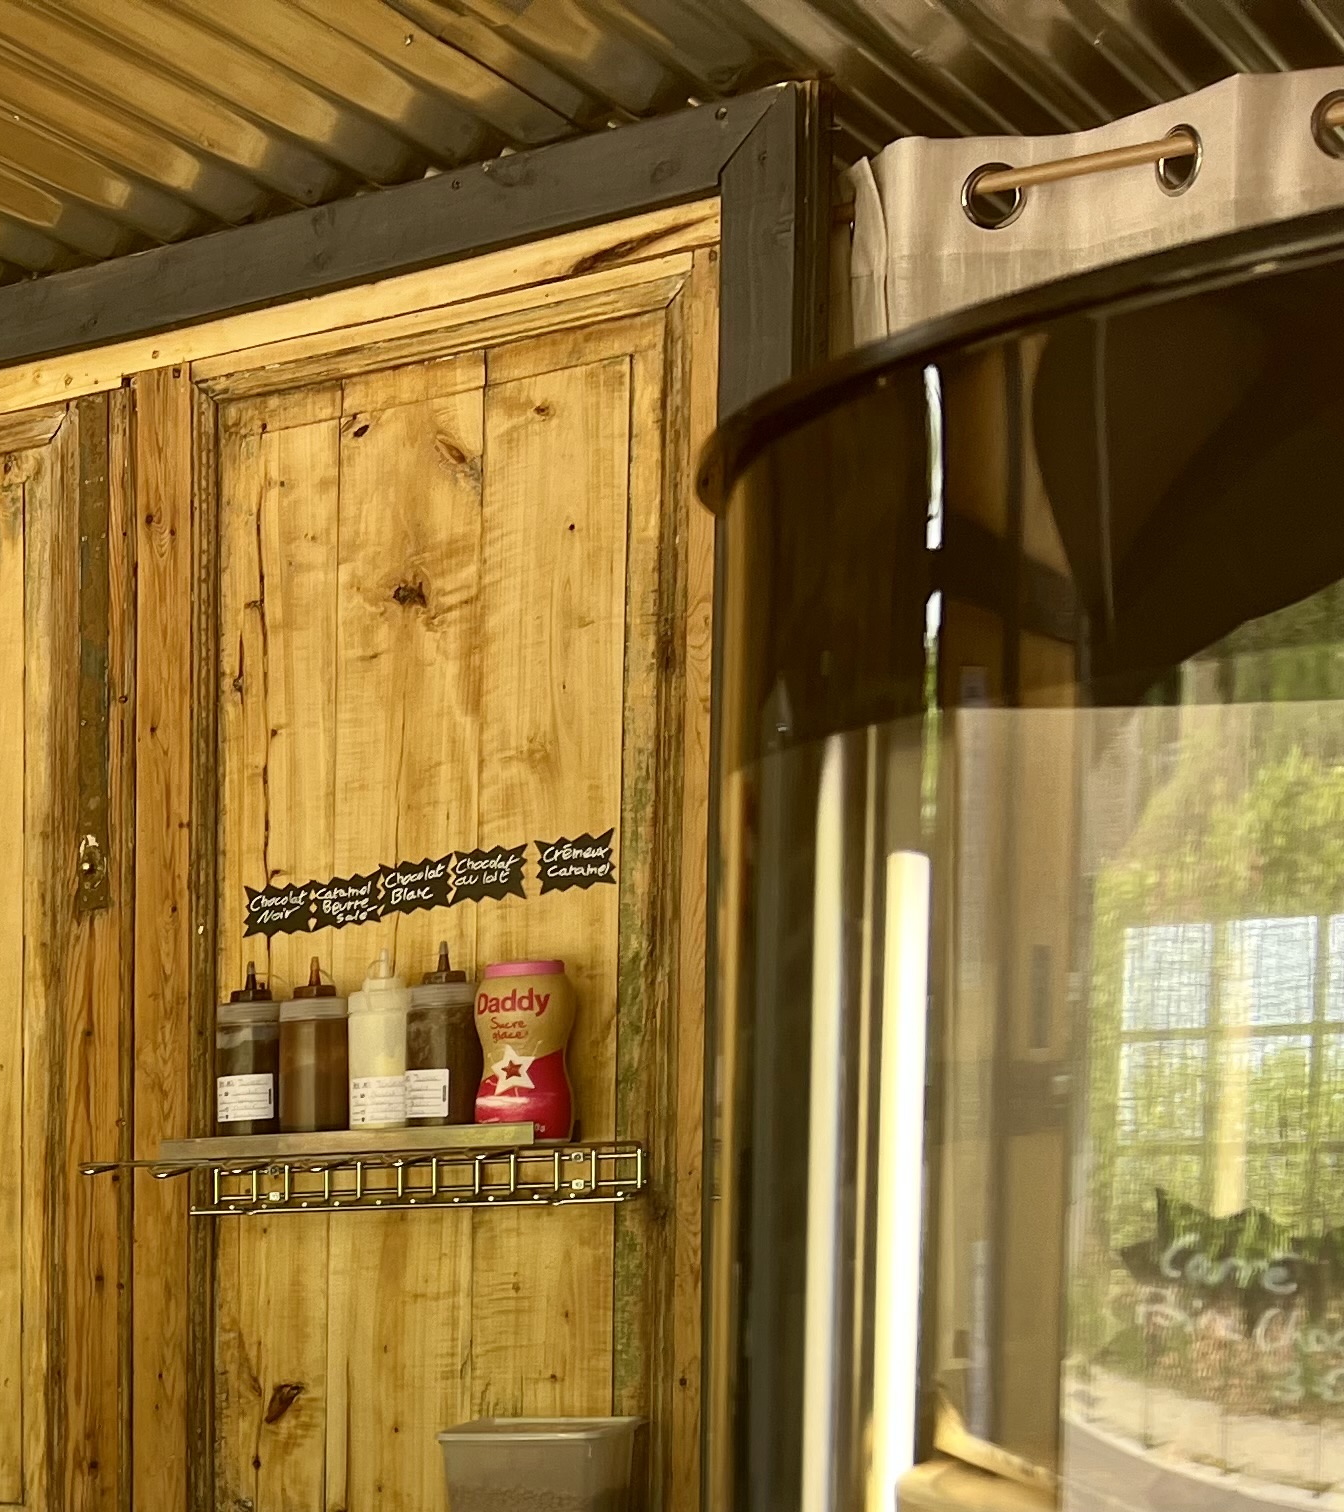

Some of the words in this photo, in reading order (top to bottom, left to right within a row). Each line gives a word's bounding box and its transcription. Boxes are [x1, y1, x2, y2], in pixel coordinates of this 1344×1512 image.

[455, 853, 521, 875] Chocolat
[384, 862, 446, 889] Chocolat
[454, 873, 479, 887] au
[482, 869, 511, 885] lait
[249, 889, 309, 912] Chocolat
[390, 886, 434, 905] Blanc
[256, 905, 301, 925] Noir
[321, 897, 370, 916] Beurre
[476, 987, 551, 1017] Daddy
[490, 1016, 527, 1030] Sucre
[491, 1030, 525, 1043] glace
